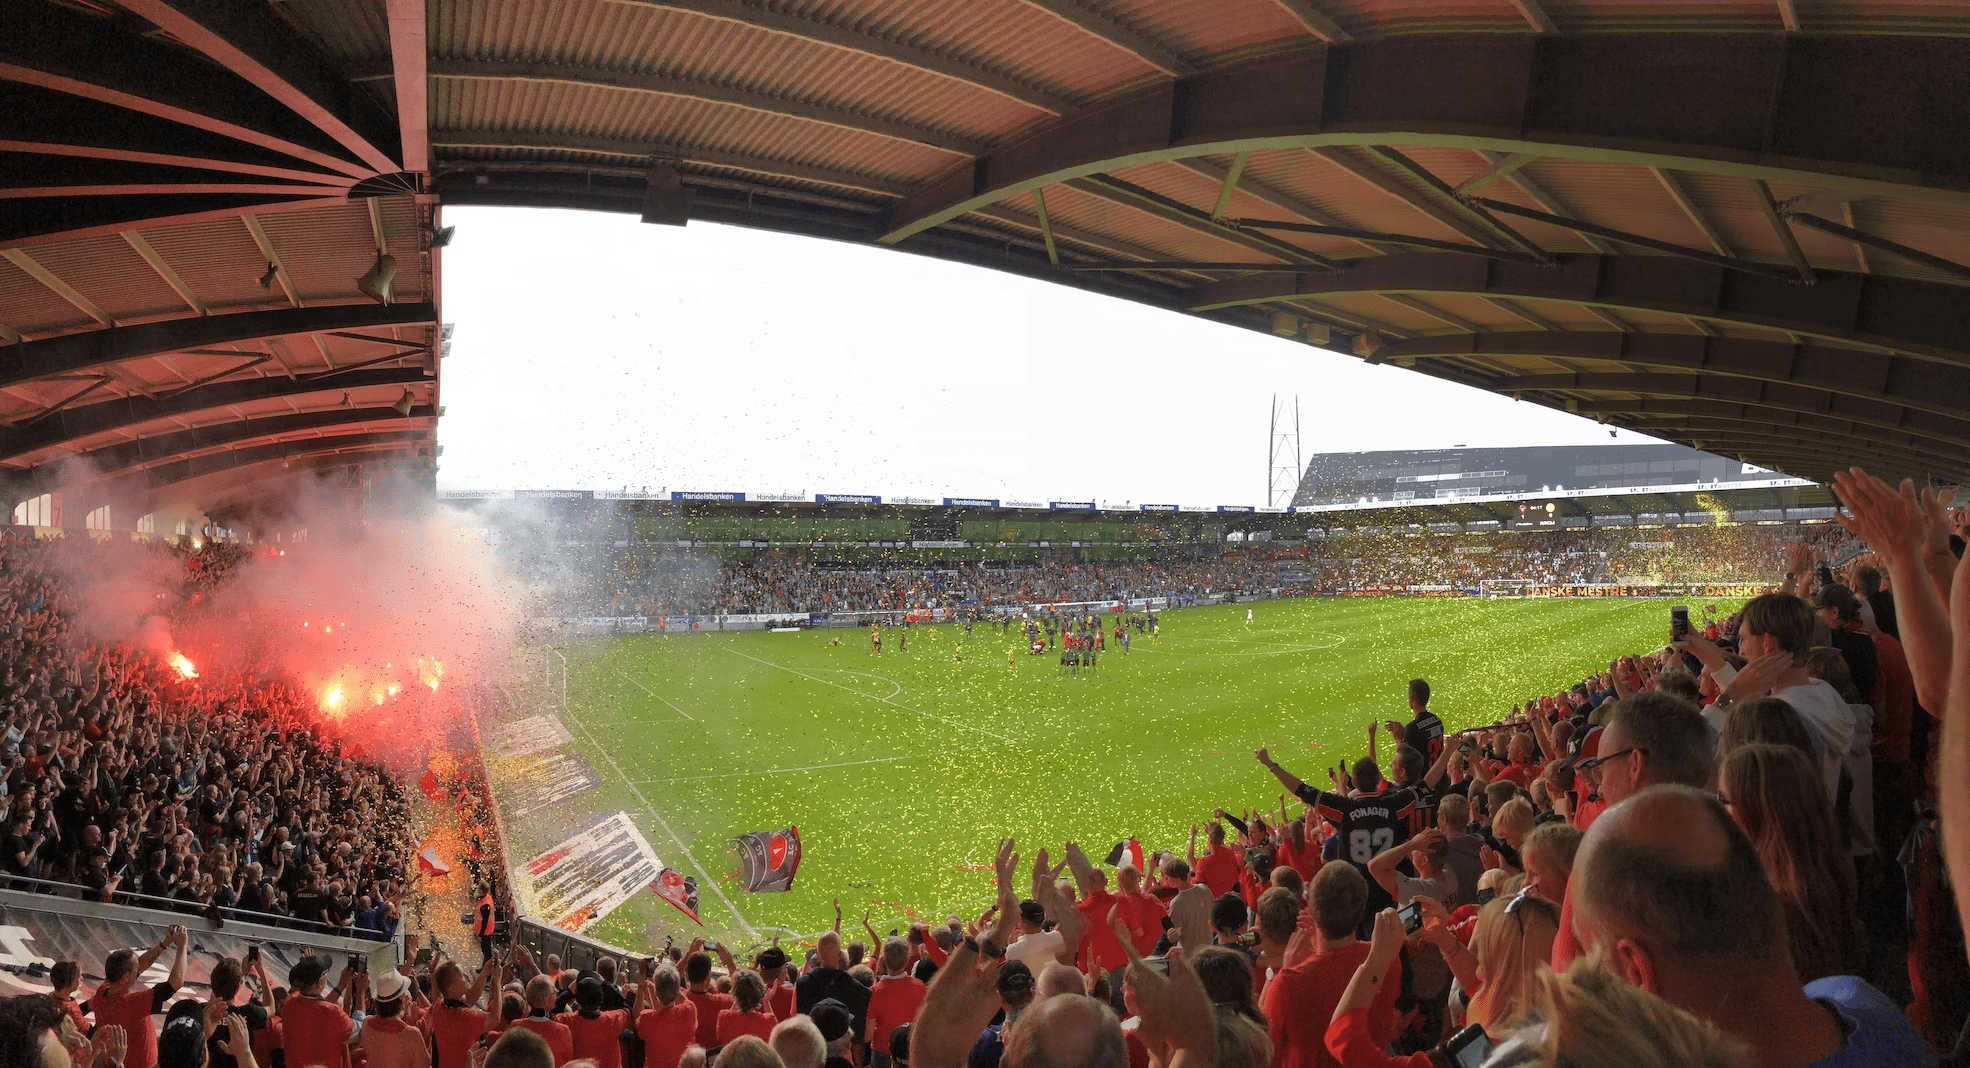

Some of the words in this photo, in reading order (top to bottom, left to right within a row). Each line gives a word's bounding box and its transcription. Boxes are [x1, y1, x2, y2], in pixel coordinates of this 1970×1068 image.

[526, 491, 583, 499] Handelsbanken
[605, 491, 659, 499] Handelsbanken
[682, 492, 735, 500] Handelsbanken
[824, 495, 873, 503] Handelsbanken
[1006, 500, 1043, 508] Handelsbanken
[1526, 586, 1575, 597] DANSKE
[1577, 585, 1628, 597] MESTRE
[1705, 585, 1762, 597] DANSKE
[1349, 806, 1390, 821] FONAGER
[1349, 826, 1394, 865] 82
